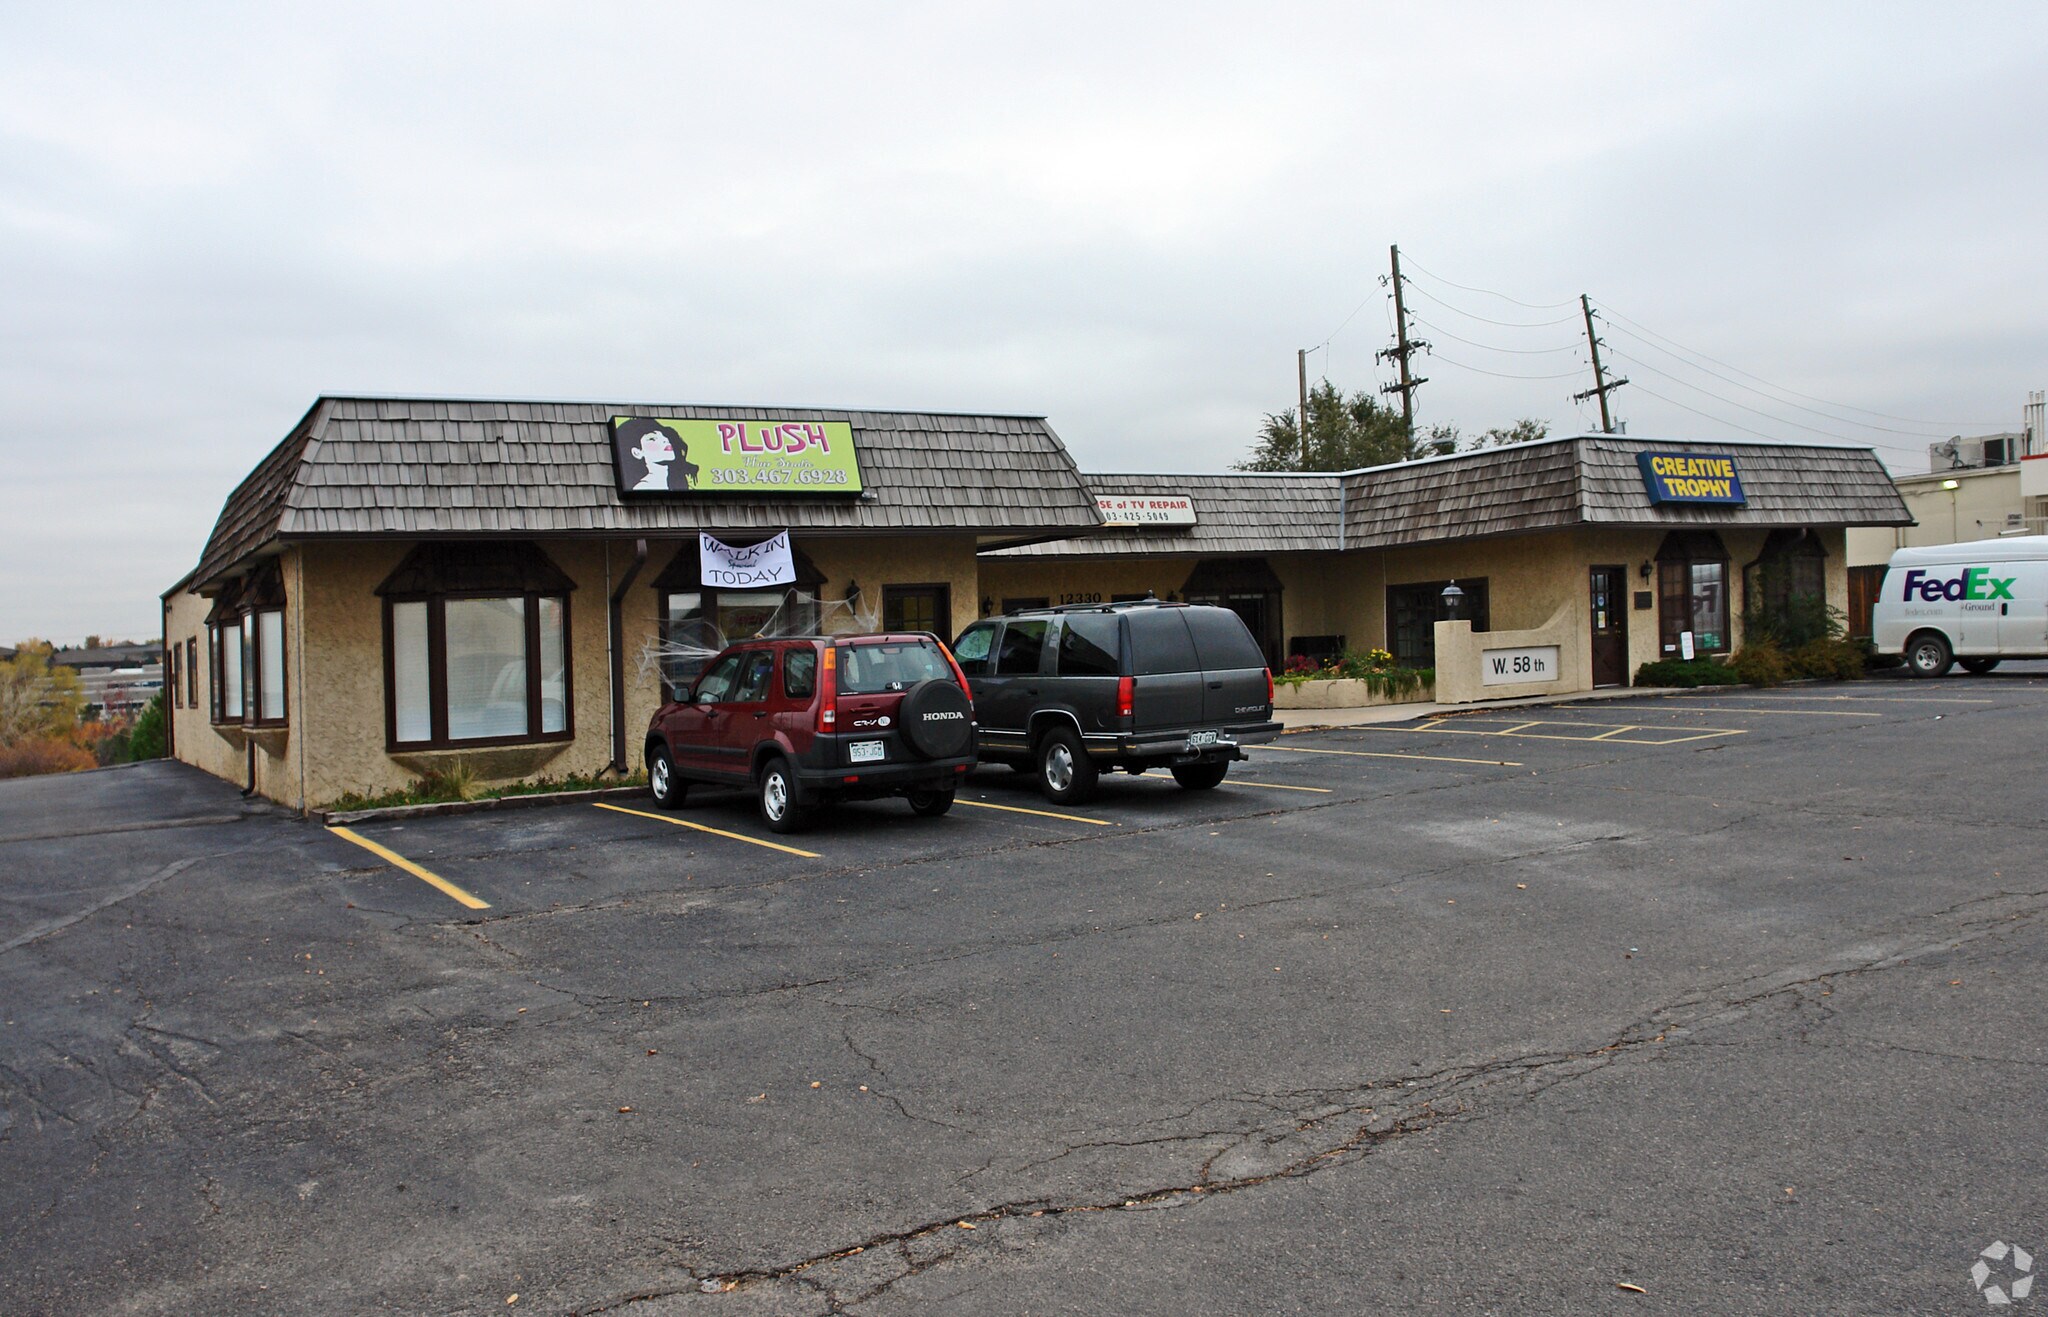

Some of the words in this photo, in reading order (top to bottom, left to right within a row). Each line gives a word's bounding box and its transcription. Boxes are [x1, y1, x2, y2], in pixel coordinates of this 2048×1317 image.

[717, 422, 831, 454] PLUSH
[710, 467, 849, 485] 303.467.6928
[1651, 456, 1735, 478] CREATIVE
[1663, 477, 1732, 498] TROPHY
[1098, 500, 1113, 509] SE
[1116, 500, 1127, 509] of
[1130, 500, 1145, 510] TV
[1149, 500, 1188, 510] REPAIR
[703, 536, 760, 561] WALK
[763, 535, 785, 554] IN
[708, 566, 782, 585] TODAY
[1903, 567, 2017, 602] FedEx
[1060, 592, 1102, 605] 12330
[1964, 602, 1995, 611] Ground
[1492, 657, 1509, 675] W.
[1513, 656, 1531, 673] 58
[1534, 658, 1545, 672] th
[922, 711, 965, 721] HONDA
